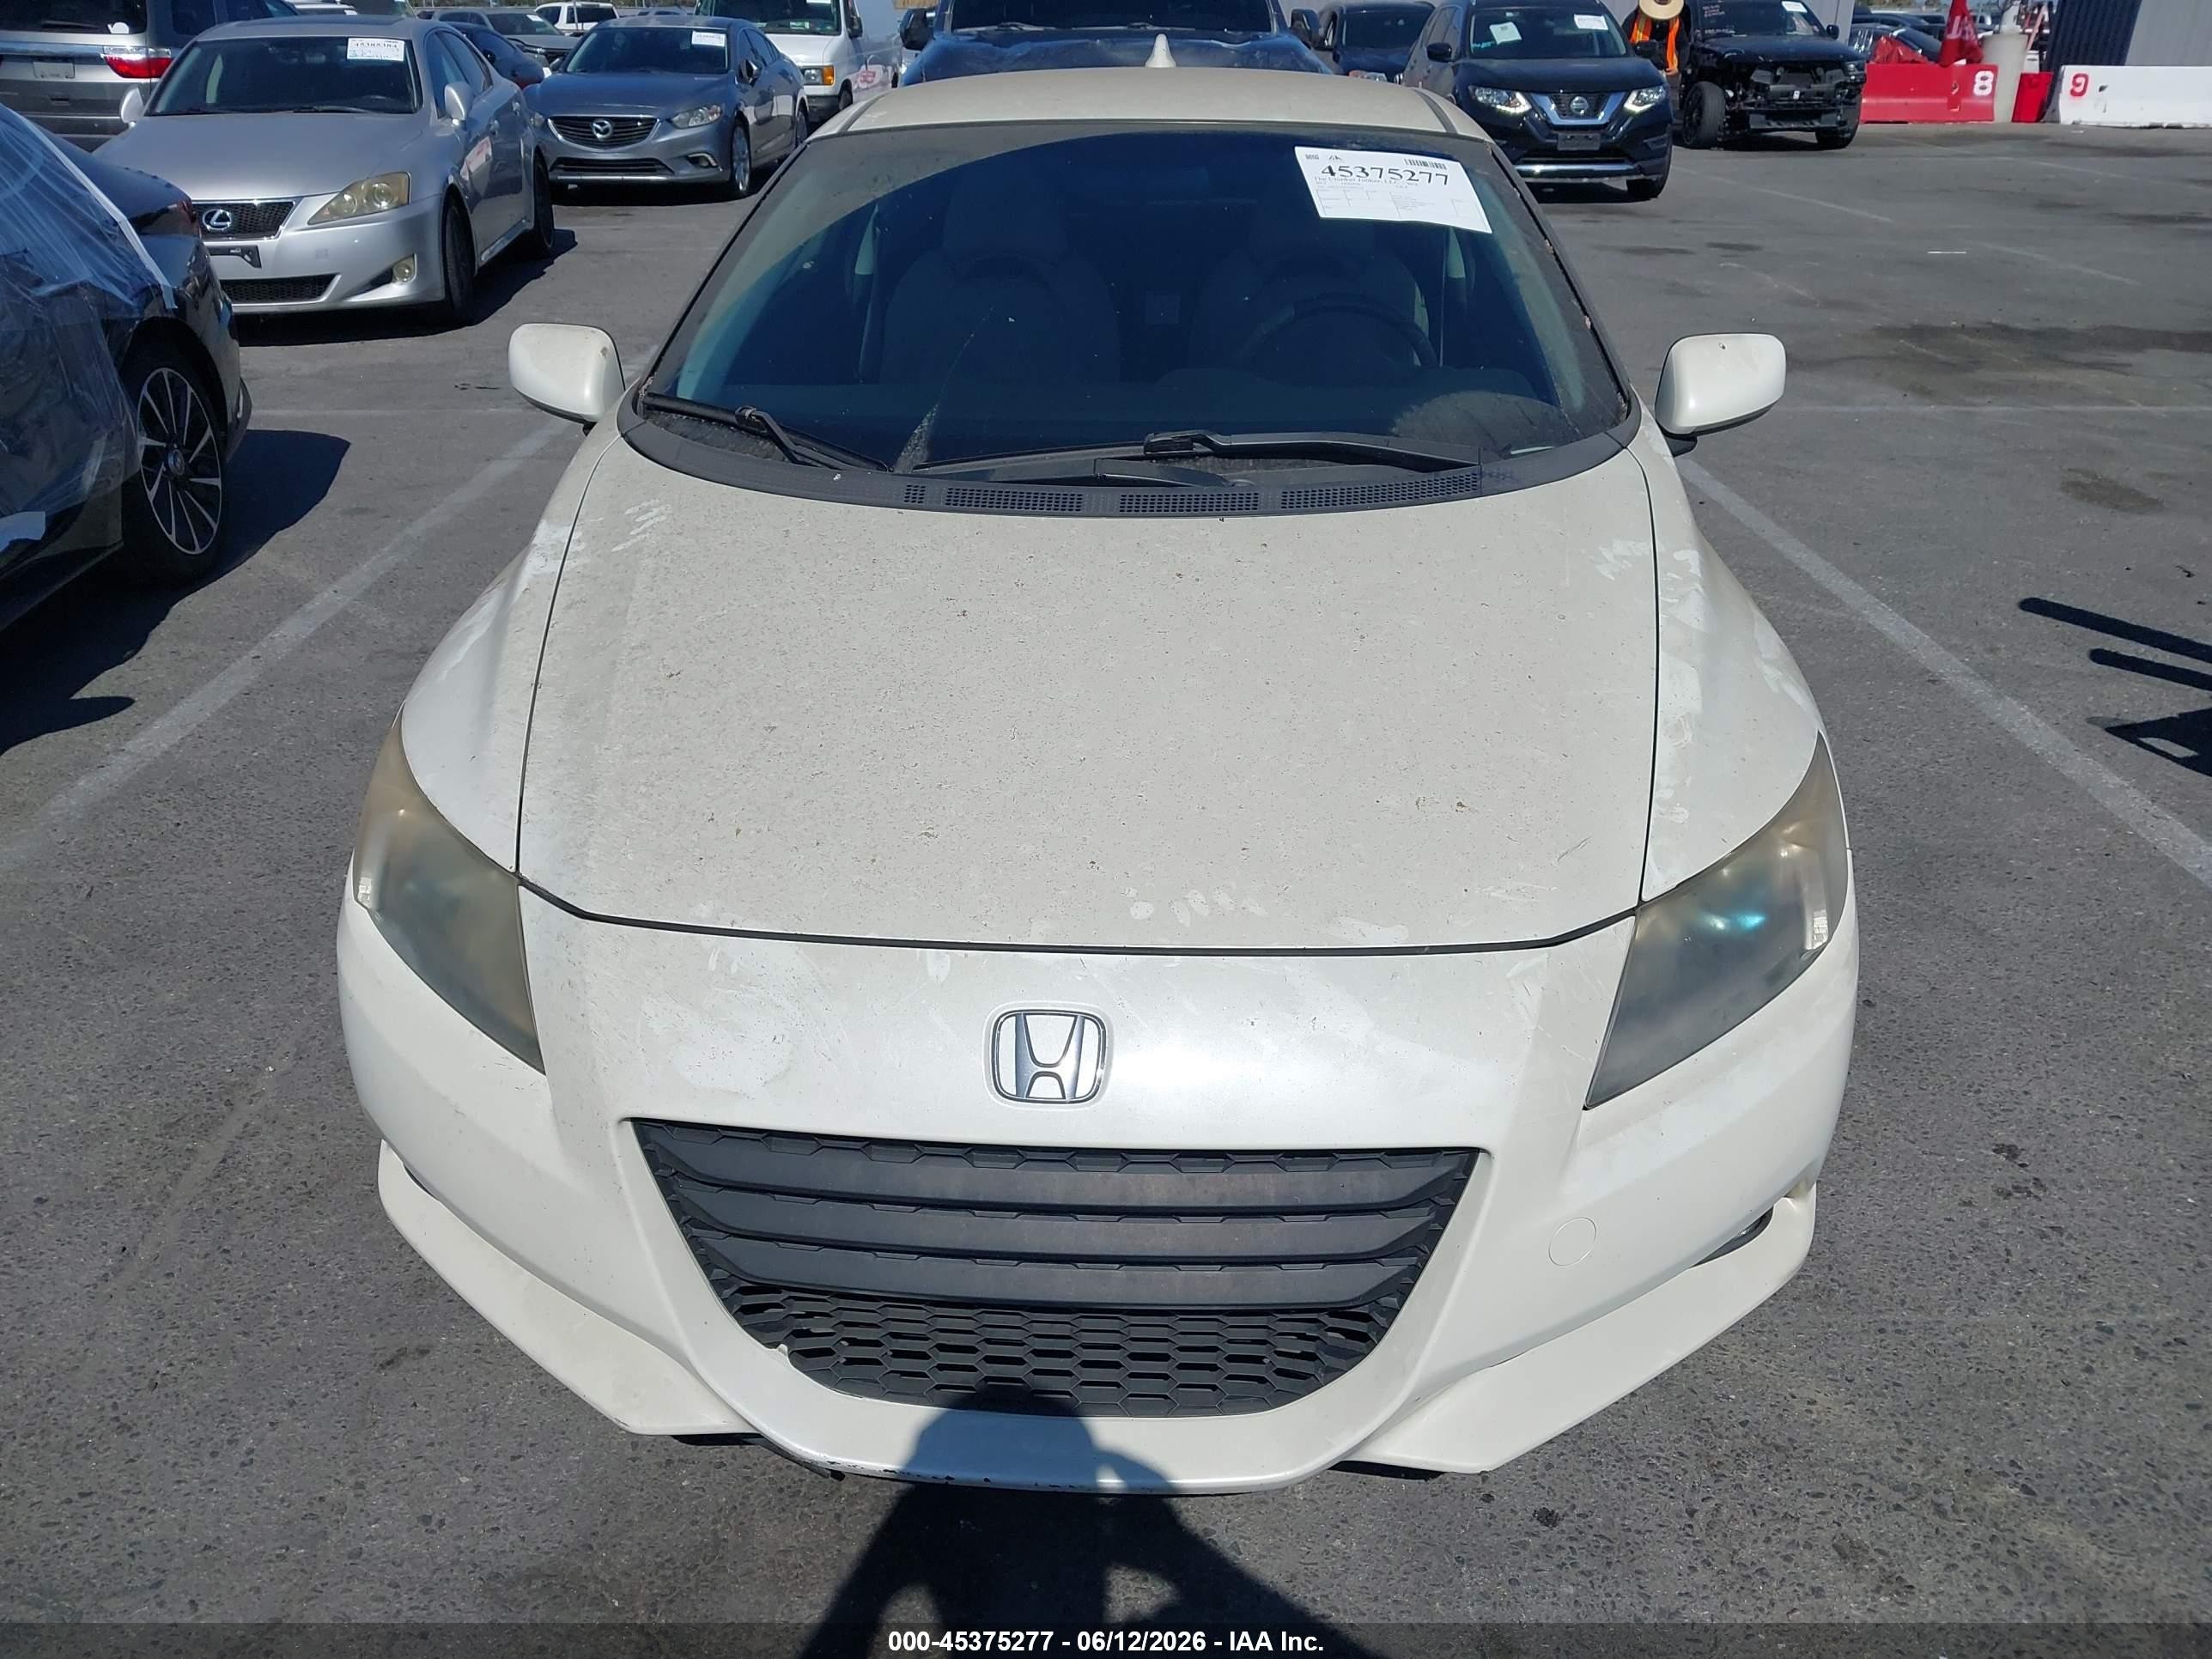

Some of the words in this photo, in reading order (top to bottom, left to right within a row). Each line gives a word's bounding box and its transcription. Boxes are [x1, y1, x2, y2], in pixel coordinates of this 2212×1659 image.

[1973, 70, 1994, 96] 8
[2069, 73, 2089, 97] 9
[1321, 164, 1449, 185] 45375277
